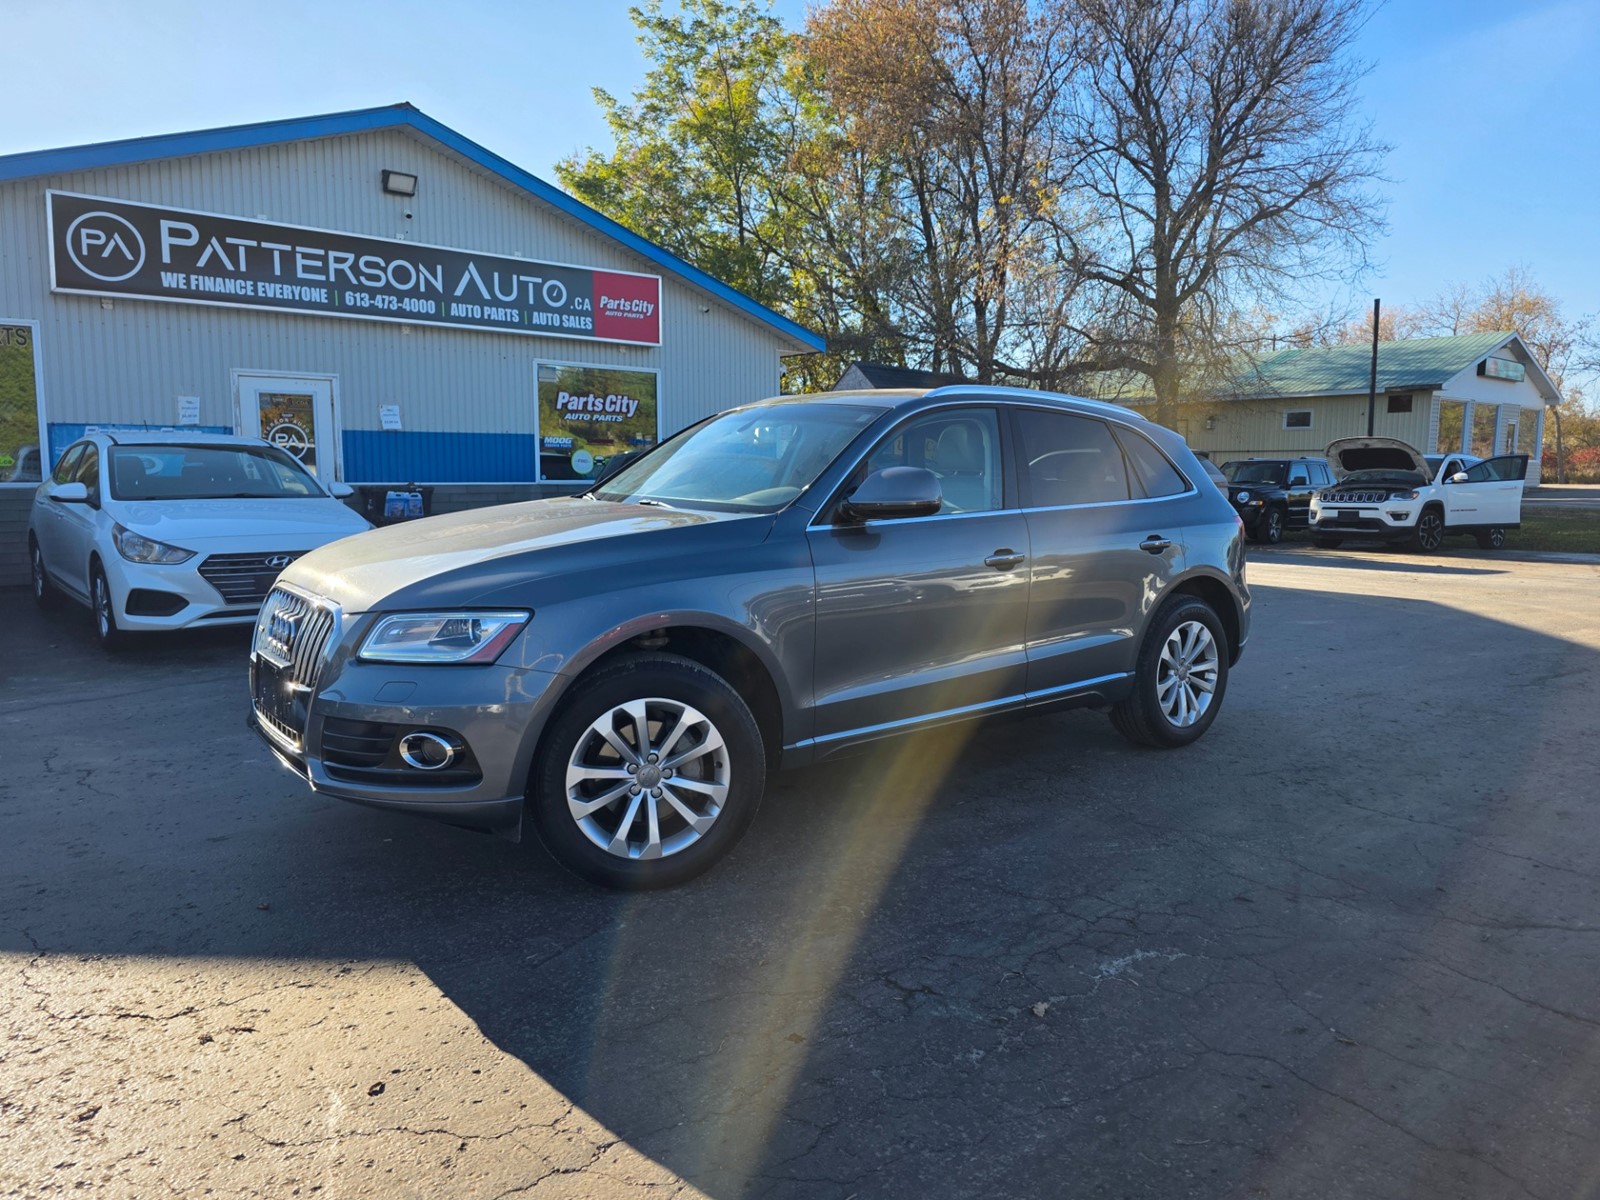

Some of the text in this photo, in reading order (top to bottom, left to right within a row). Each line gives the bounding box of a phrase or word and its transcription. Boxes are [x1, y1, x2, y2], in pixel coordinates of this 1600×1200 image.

[159, 219, 592, 312] PATTERSON AUTO .CA
[160, 271, 593, 330] WE FINANCE EVERYONE 613-473-4000 AUTO PARTS AUTO SALES
[0, 327, 27, 345] TS
[564, 412, 624, 422] AUTO PARTS
[544, 436, 573, 444] MOOG
